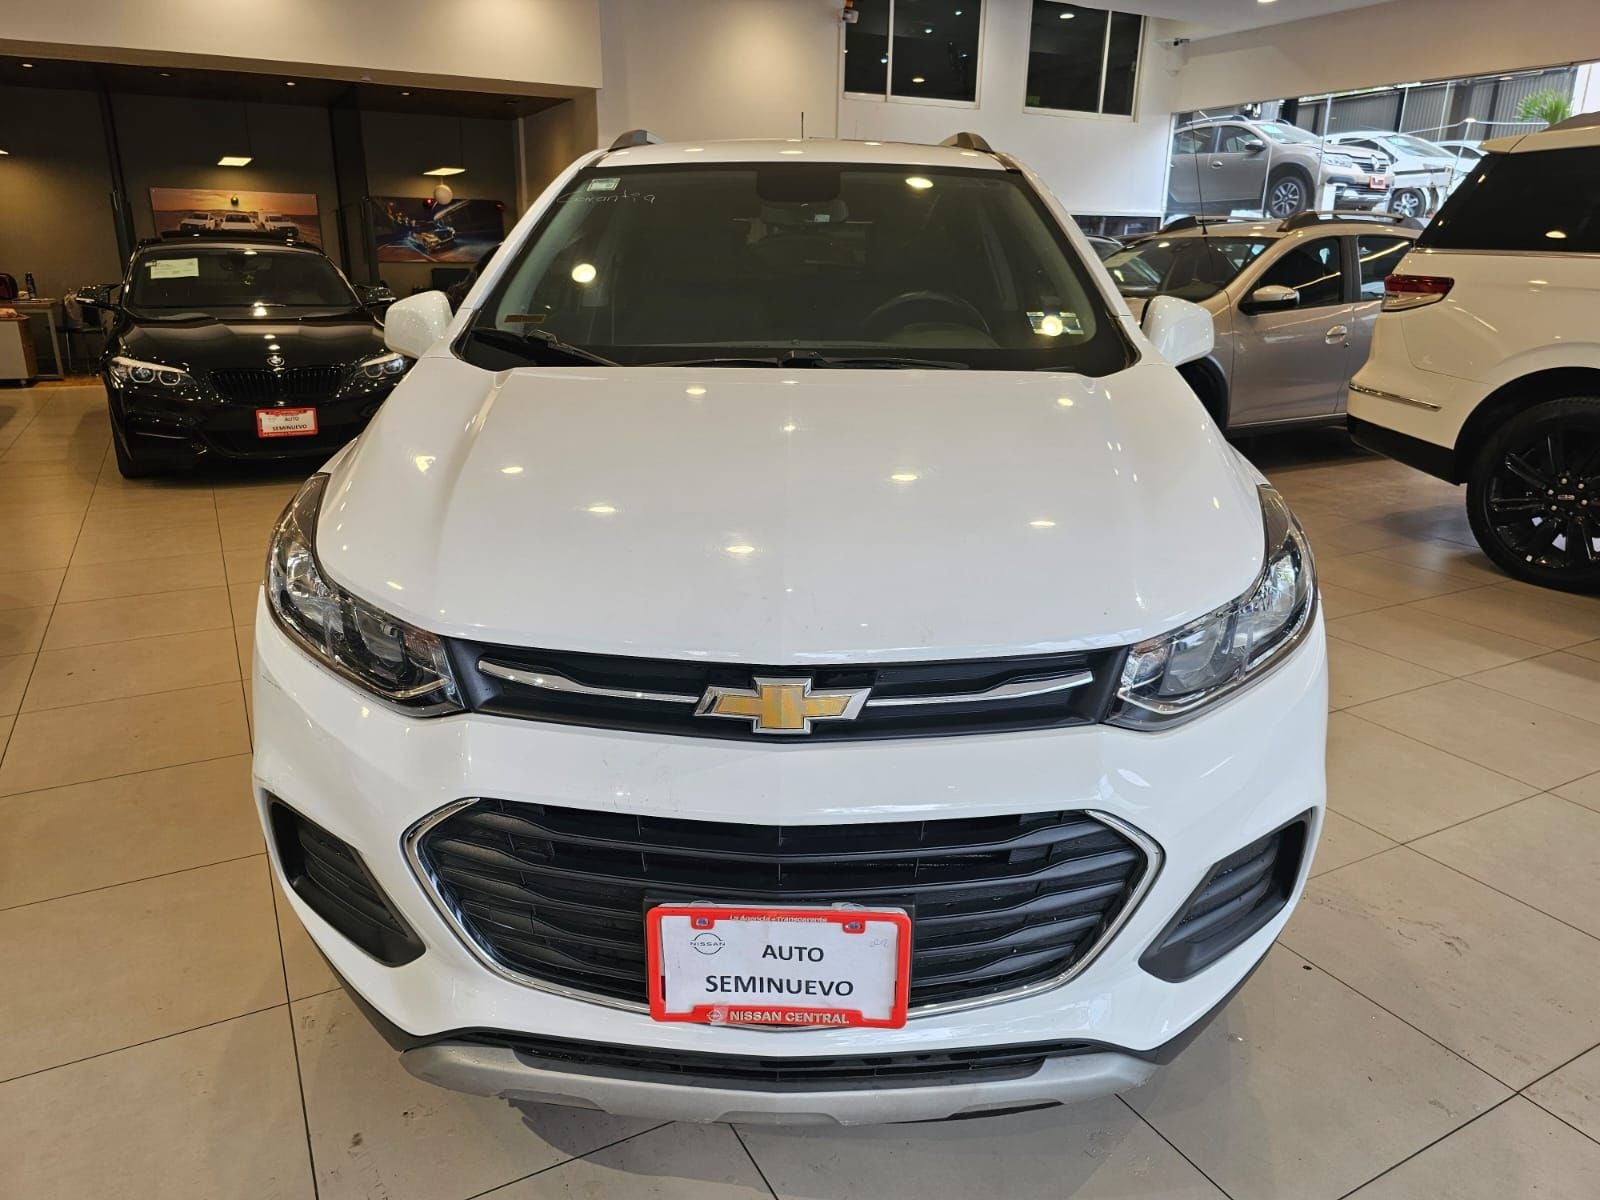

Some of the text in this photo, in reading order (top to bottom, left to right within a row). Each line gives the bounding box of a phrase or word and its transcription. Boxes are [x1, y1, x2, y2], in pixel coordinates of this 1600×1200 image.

[762, 944, 824, 962] AUTO
[705, 975, 854, 996] SEMINUEVO
[729, 1011, 782, 1021] NISSAN
[785, 1012, 849, 1024] CENTRAL
